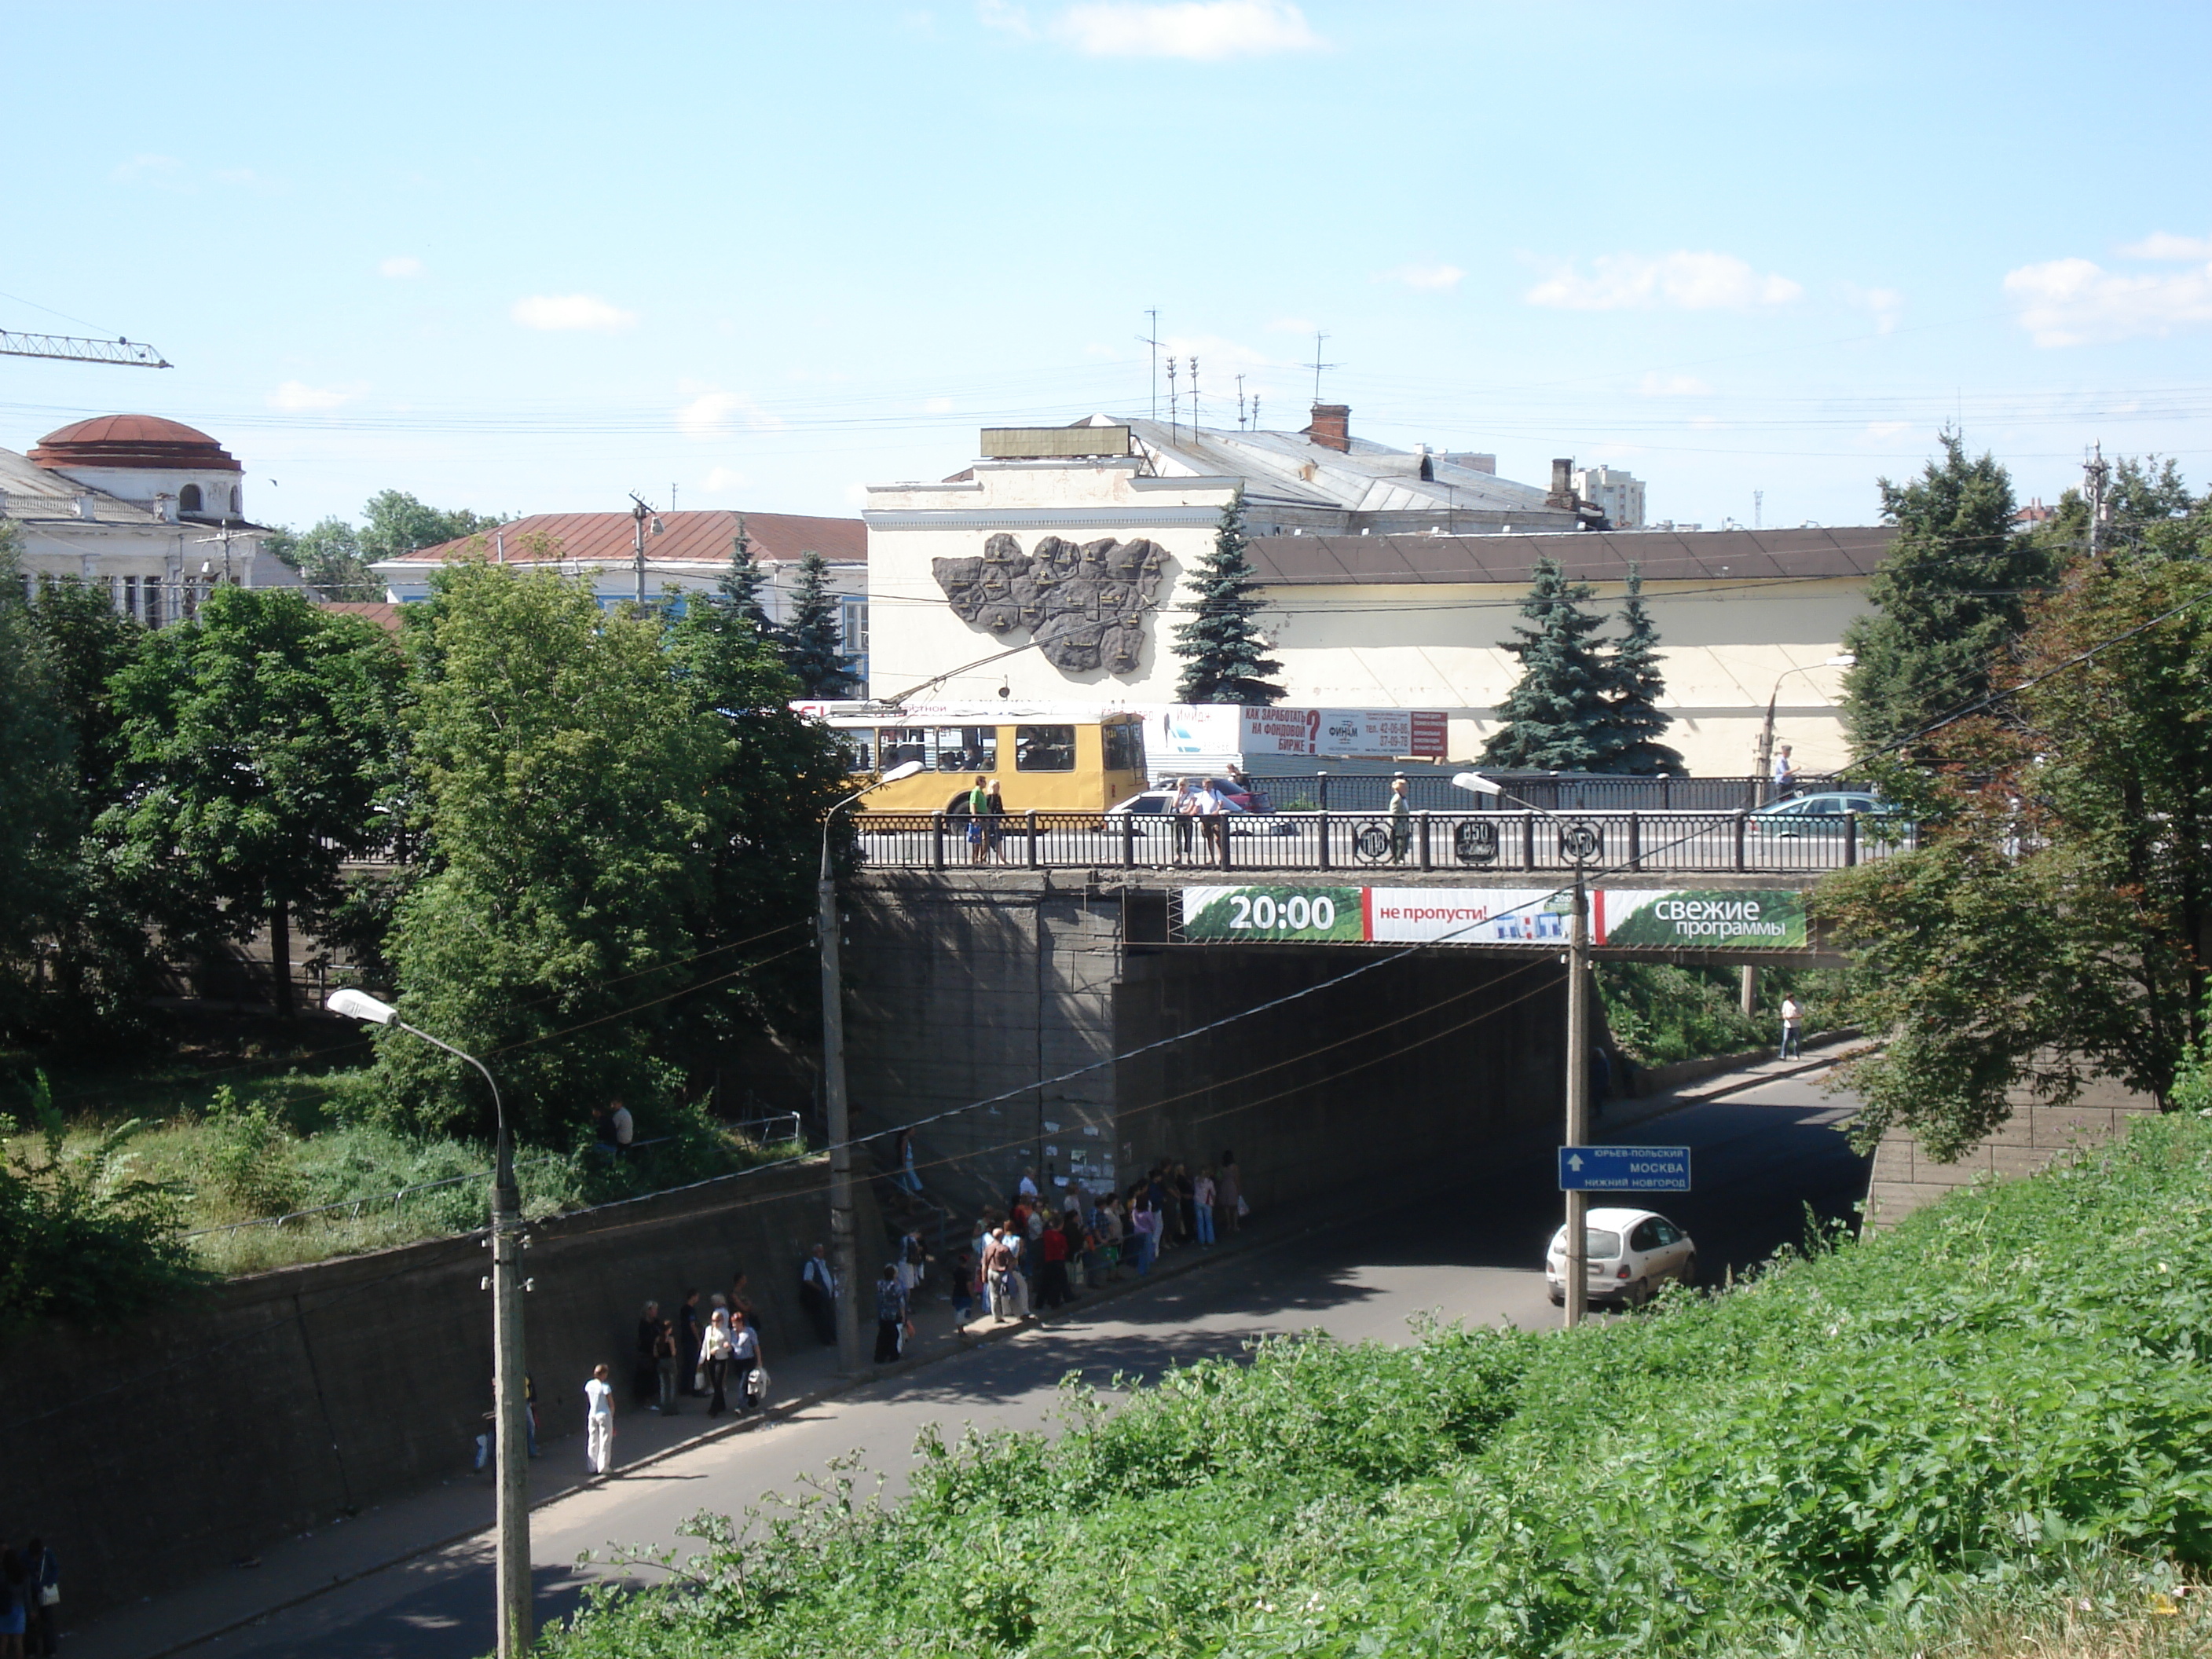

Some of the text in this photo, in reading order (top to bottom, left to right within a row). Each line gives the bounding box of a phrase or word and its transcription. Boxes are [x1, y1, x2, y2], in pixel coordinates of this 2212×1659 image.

[1245, 707, 1306, 723] КАК ЗАРАБОТАТЬ
[1251, 722, 1306, 738] НА ФОНДОВОЙ
[1328, 726, 1358, 738] ФИНАМ
[1278, 738, 1306, 752] БИРЖЕ
[1554, 894, 1574, 903] 20:0
[1229, 895, 1336, 930] 20:00
[1380, 905, 1489, 924] не пропусти!
[1654, 900, 1760, 921] свежие
[1675, 921, 1786, 940] программы
[1629, 1162, 1685, 1174] МОСКВА
[1584, 1177, 1686, 1188] НИЖНИЙ НОВГОРОД
